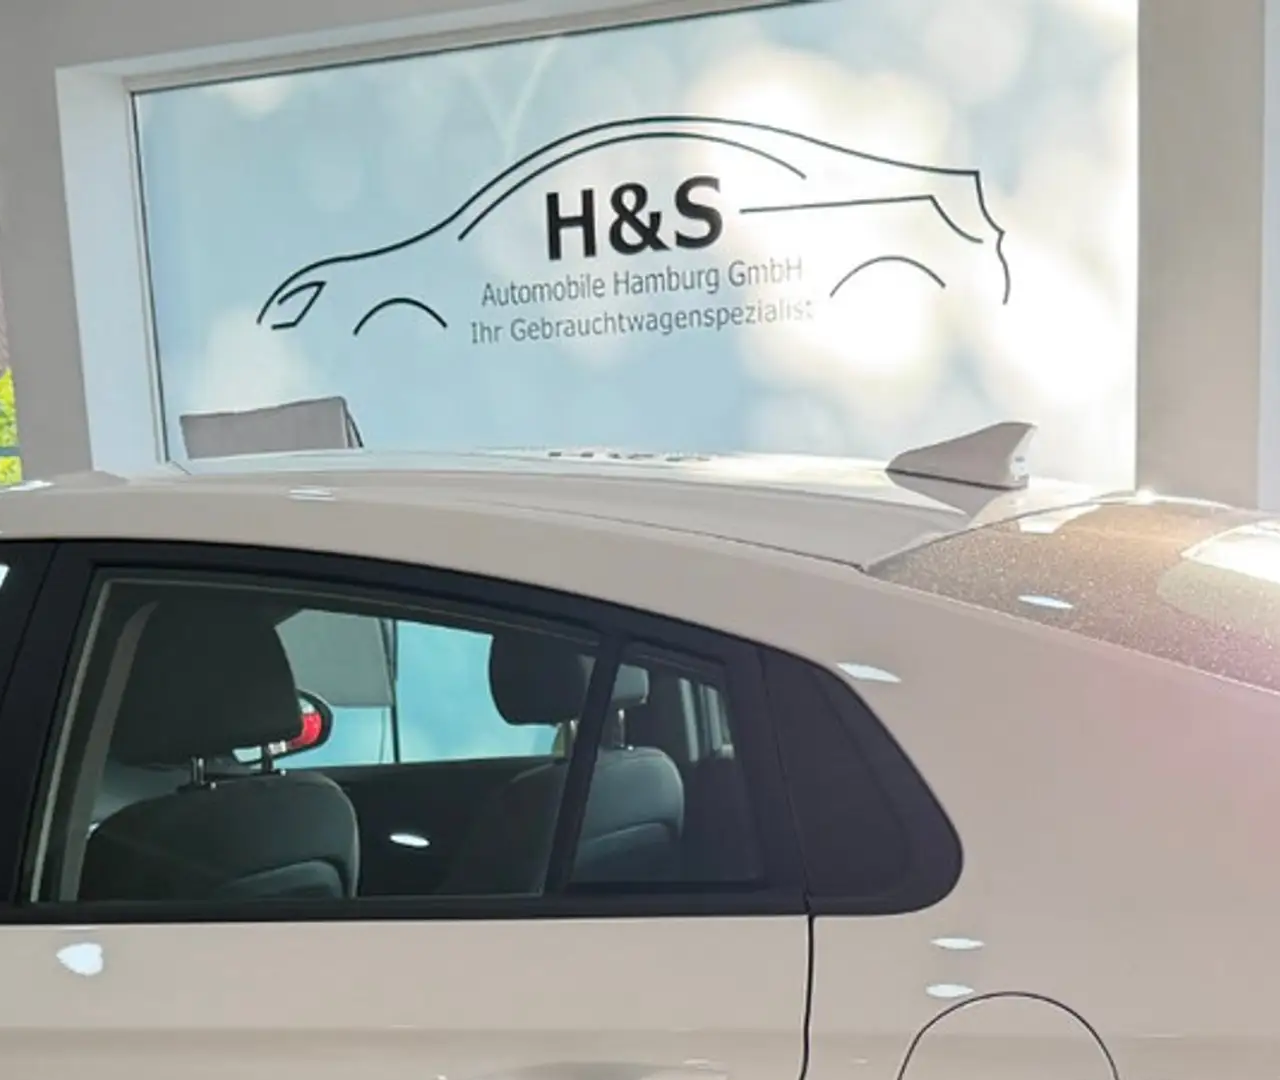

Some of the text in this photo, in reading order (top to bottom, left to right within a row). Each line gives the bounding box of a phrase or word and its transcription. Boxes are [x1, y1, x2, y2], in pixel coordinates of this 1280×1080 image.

[545, 175, 724, 261] H&S
[481, 257, 804, 308] Automobile Hamburg GmbH
[470, 299, 816, 345] Ihr Gebrauchtwagenspezialist
